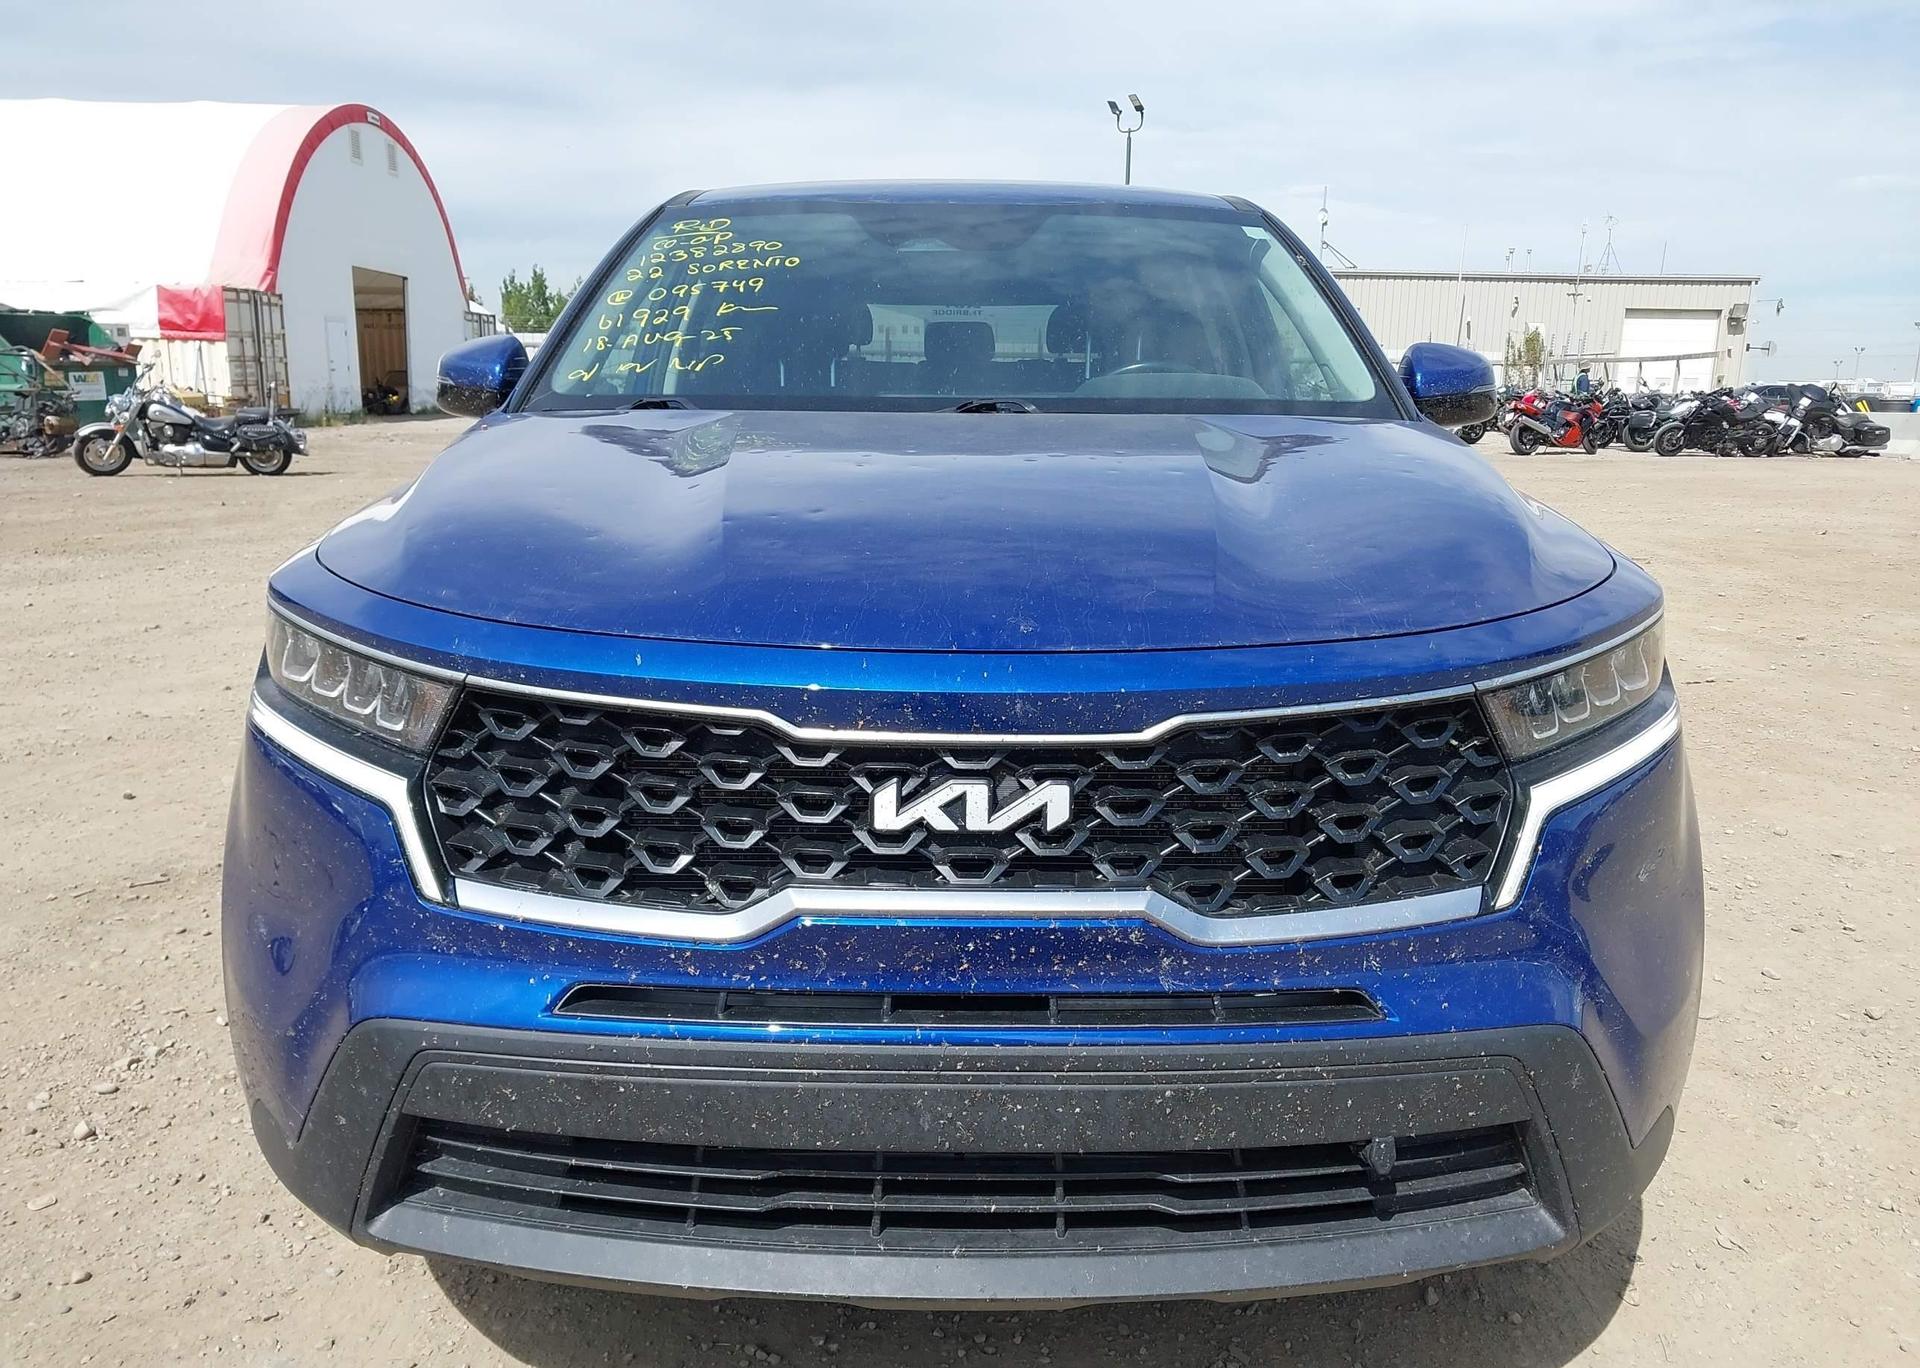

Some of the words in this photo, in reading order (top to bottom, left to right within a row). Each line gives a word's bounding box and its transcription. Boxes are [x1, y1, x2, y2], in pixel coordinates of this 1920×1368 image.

[640, 240, 783, 267] 12382890
[627, 266, 664, 281] 22
[687, 256, 801, 275] SORENTO
[649, 278, 765, 302] 095749
